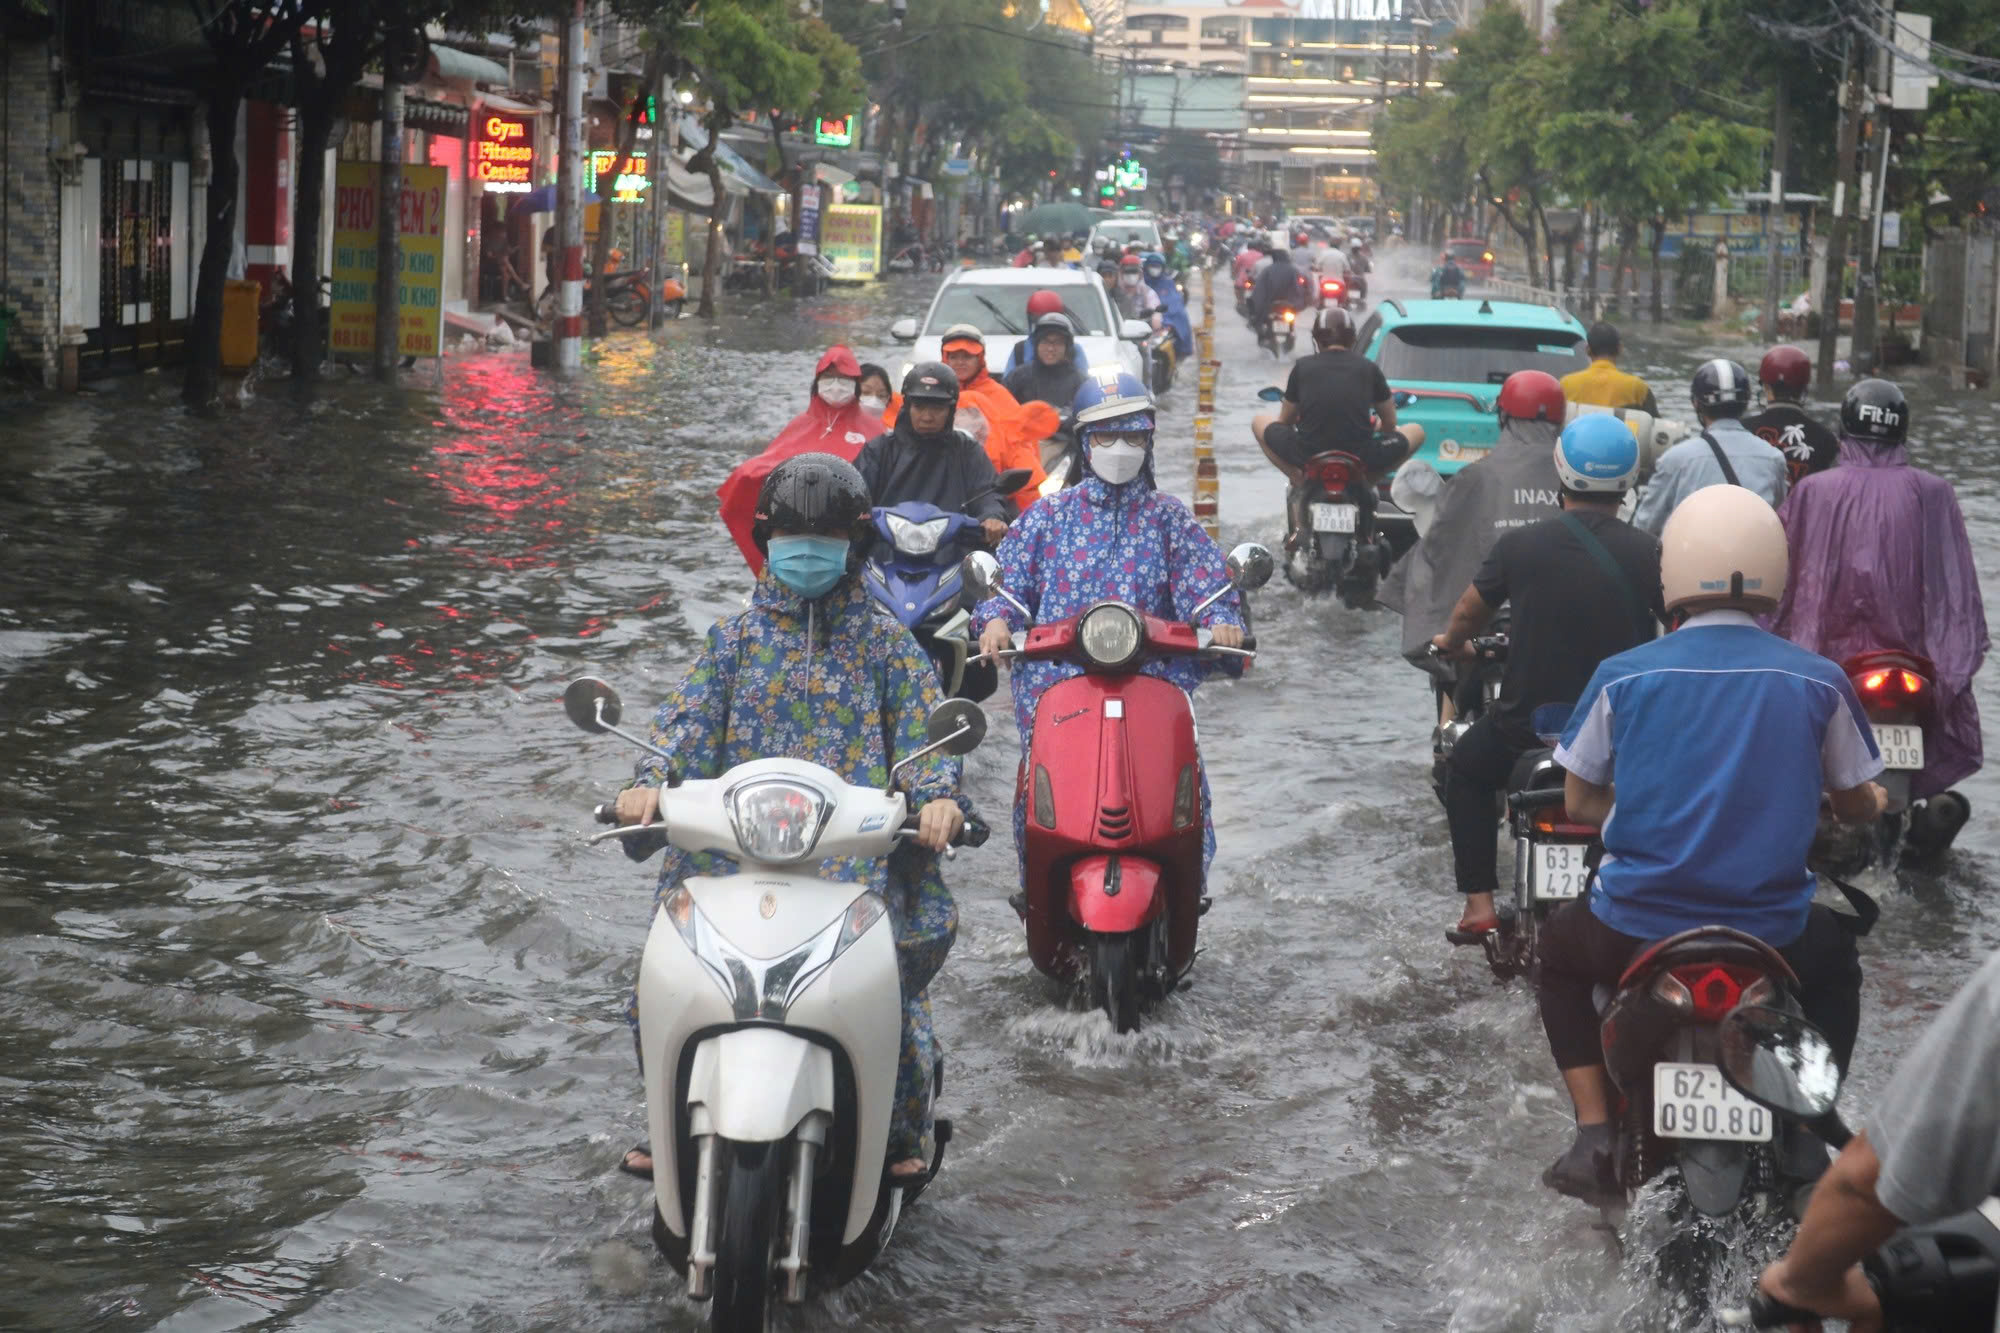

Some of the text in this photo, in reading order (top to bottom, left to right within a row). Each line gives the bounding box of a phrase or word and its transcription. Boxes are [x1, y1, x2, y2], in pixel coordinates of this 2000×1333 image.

[487, 117, 524, 142] Gym
[479, 141, 532, 161] Fitness
[479, 161, 529, 181] Center
[431, 186, 441, 234] 2
[1514, 488, 1563, 507] INAX
[1877, 728, 1910, 747] 1-D1
[1546, 847, 1586, 870] 63-
[1662, 1103, 1763, 1136] 090.80
